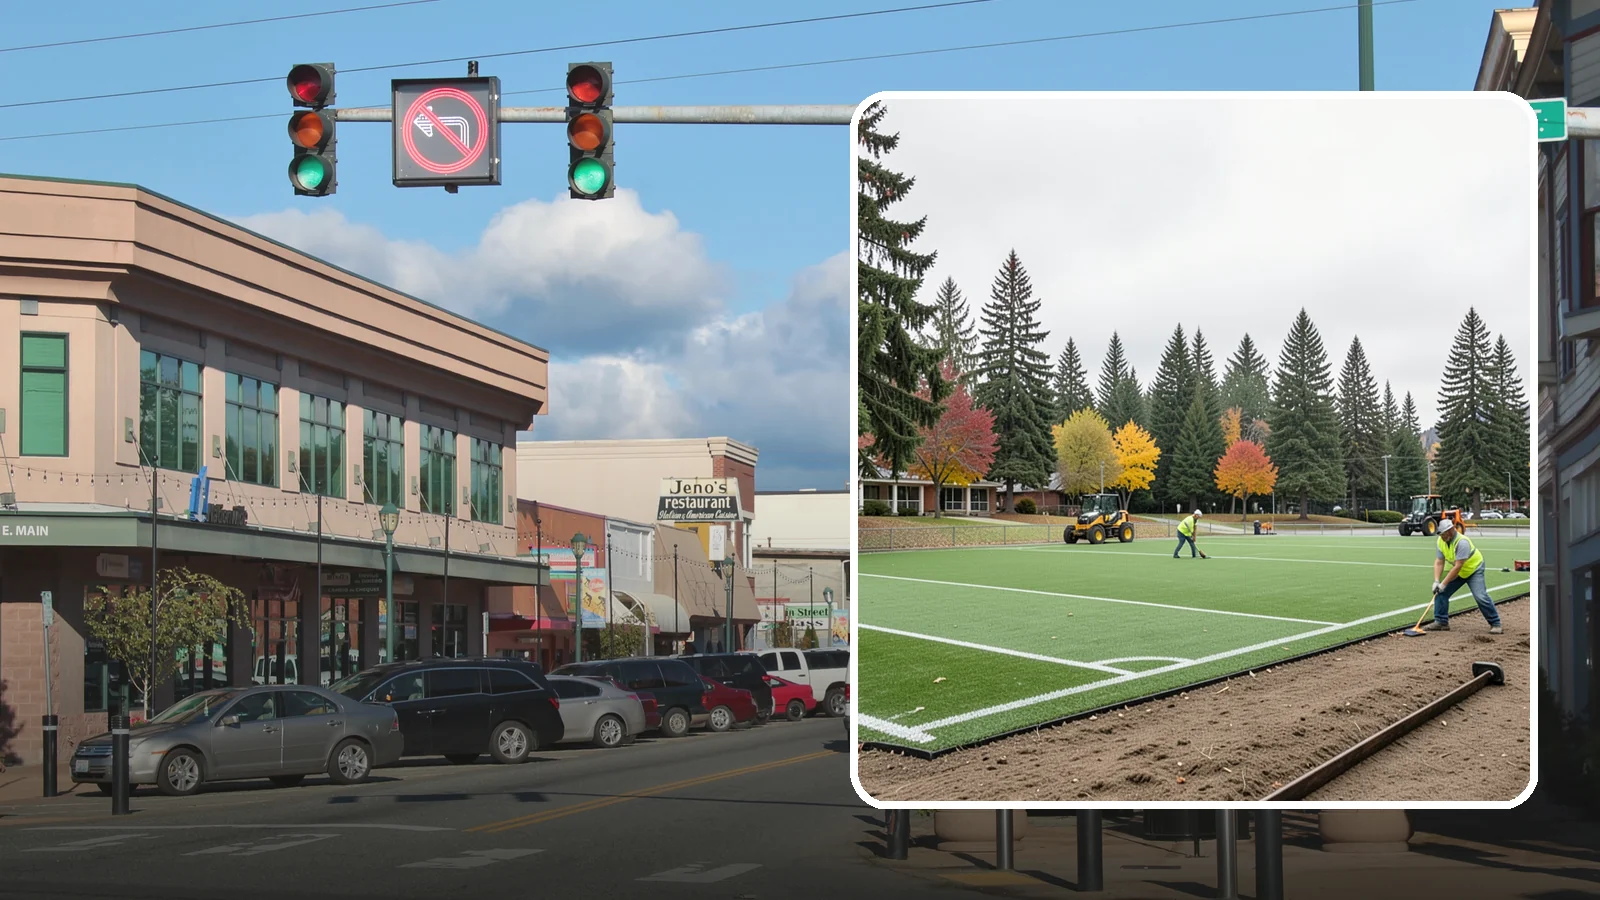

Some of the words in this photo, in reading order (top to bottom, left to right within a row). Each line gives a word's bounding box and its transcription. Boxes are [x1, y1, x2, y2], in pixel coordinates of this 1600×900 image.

[669, 480, 728, 494] Jeno's
[665, 496, 730, 509] restaurant
[658, 510, 682, 520] Italian
[686, 509, 714, 519] American
[715, 509, 738, 520] Cuisine
[2, 525, 13, 536] E.
[15, 525, 49, 536] MAIN
[797, 607, 829, 616] Street
